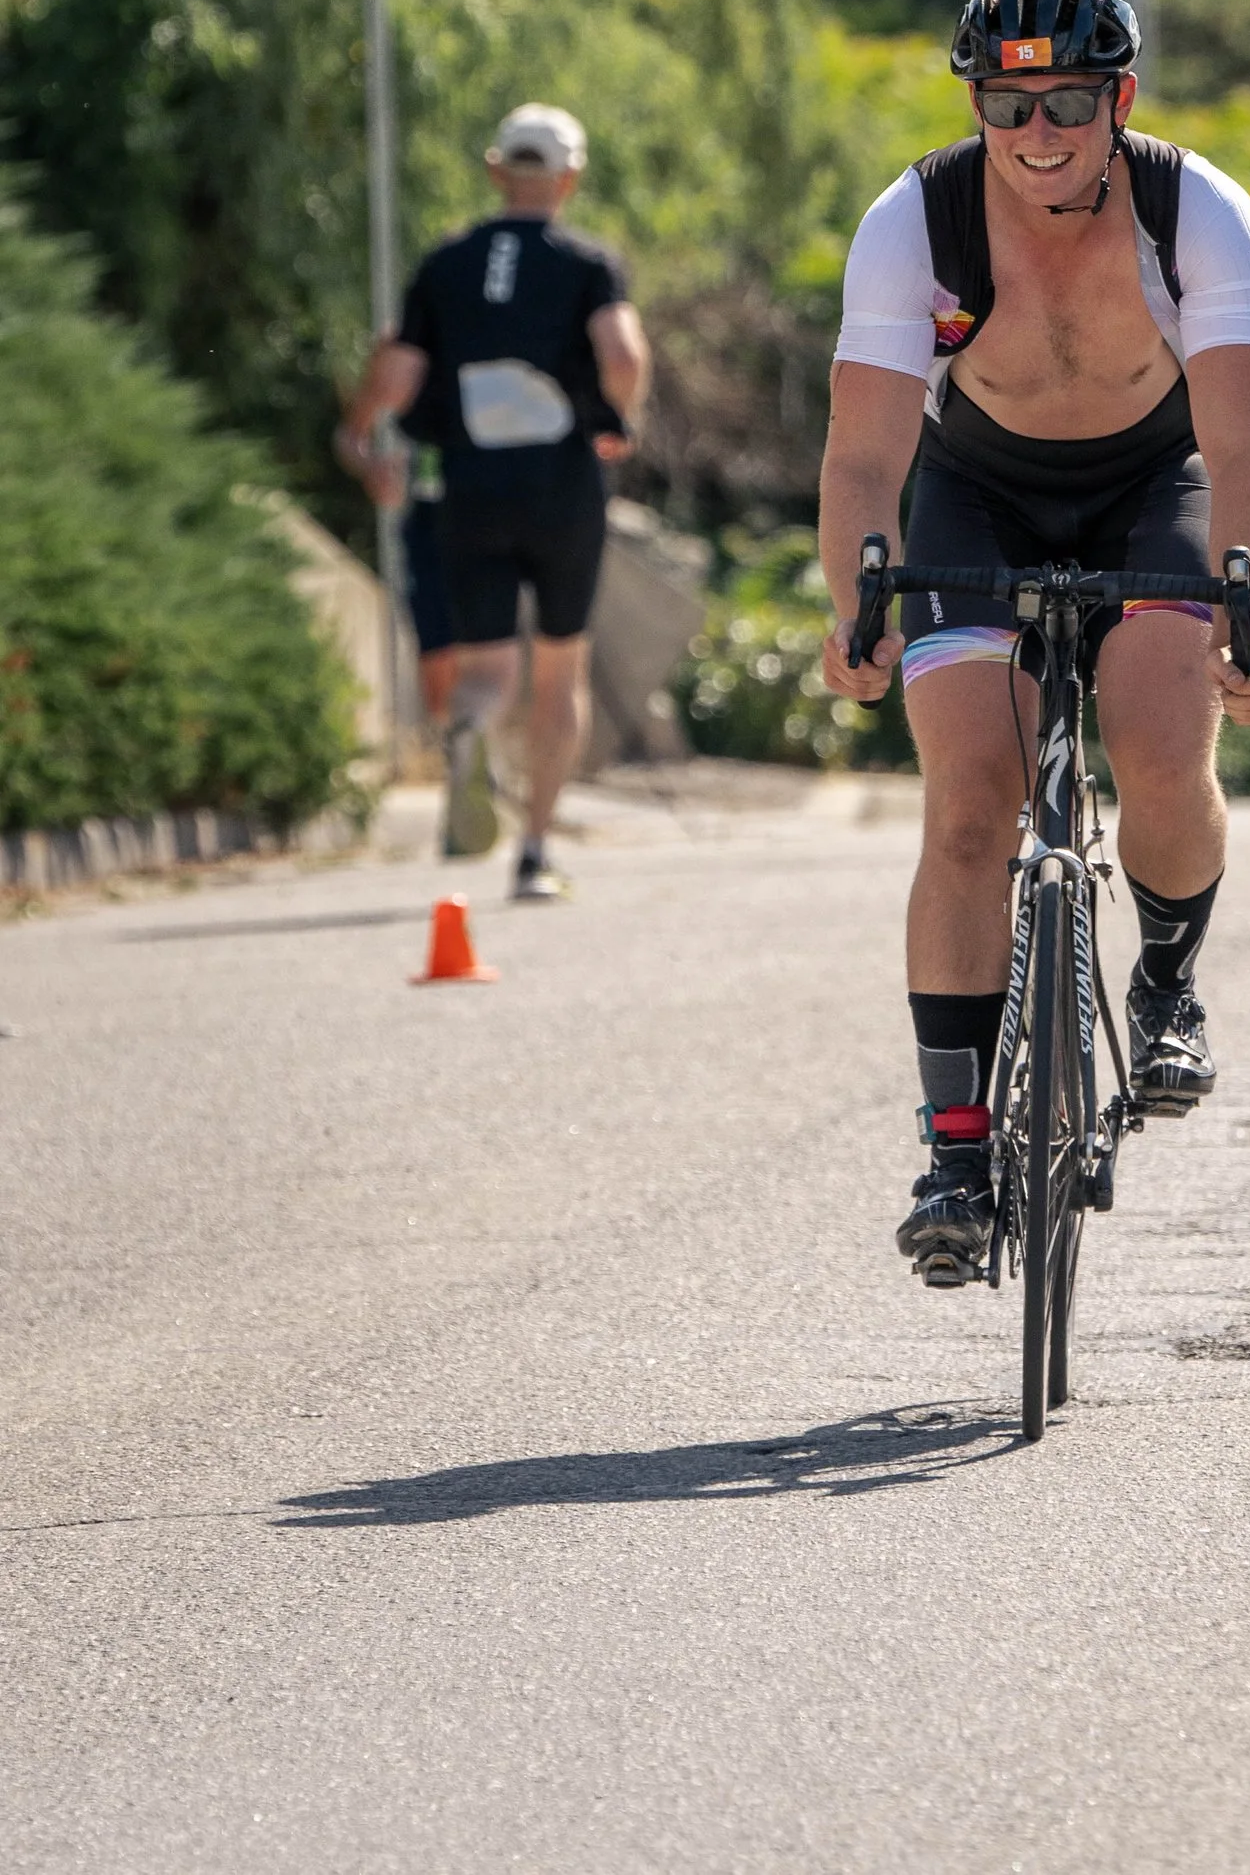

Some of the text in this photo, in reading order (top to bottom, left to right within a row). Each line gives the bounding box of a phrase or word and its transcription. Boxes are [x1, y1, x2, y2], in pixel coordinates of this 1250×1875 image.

[1016, 44, 1034, 60] 15
[928, 591, 944, 624] RNEAU
[1002, 904, 1032, 1060] SPECIALIZED
[1072, 902, 1094, 1060] SPECIALIZED
